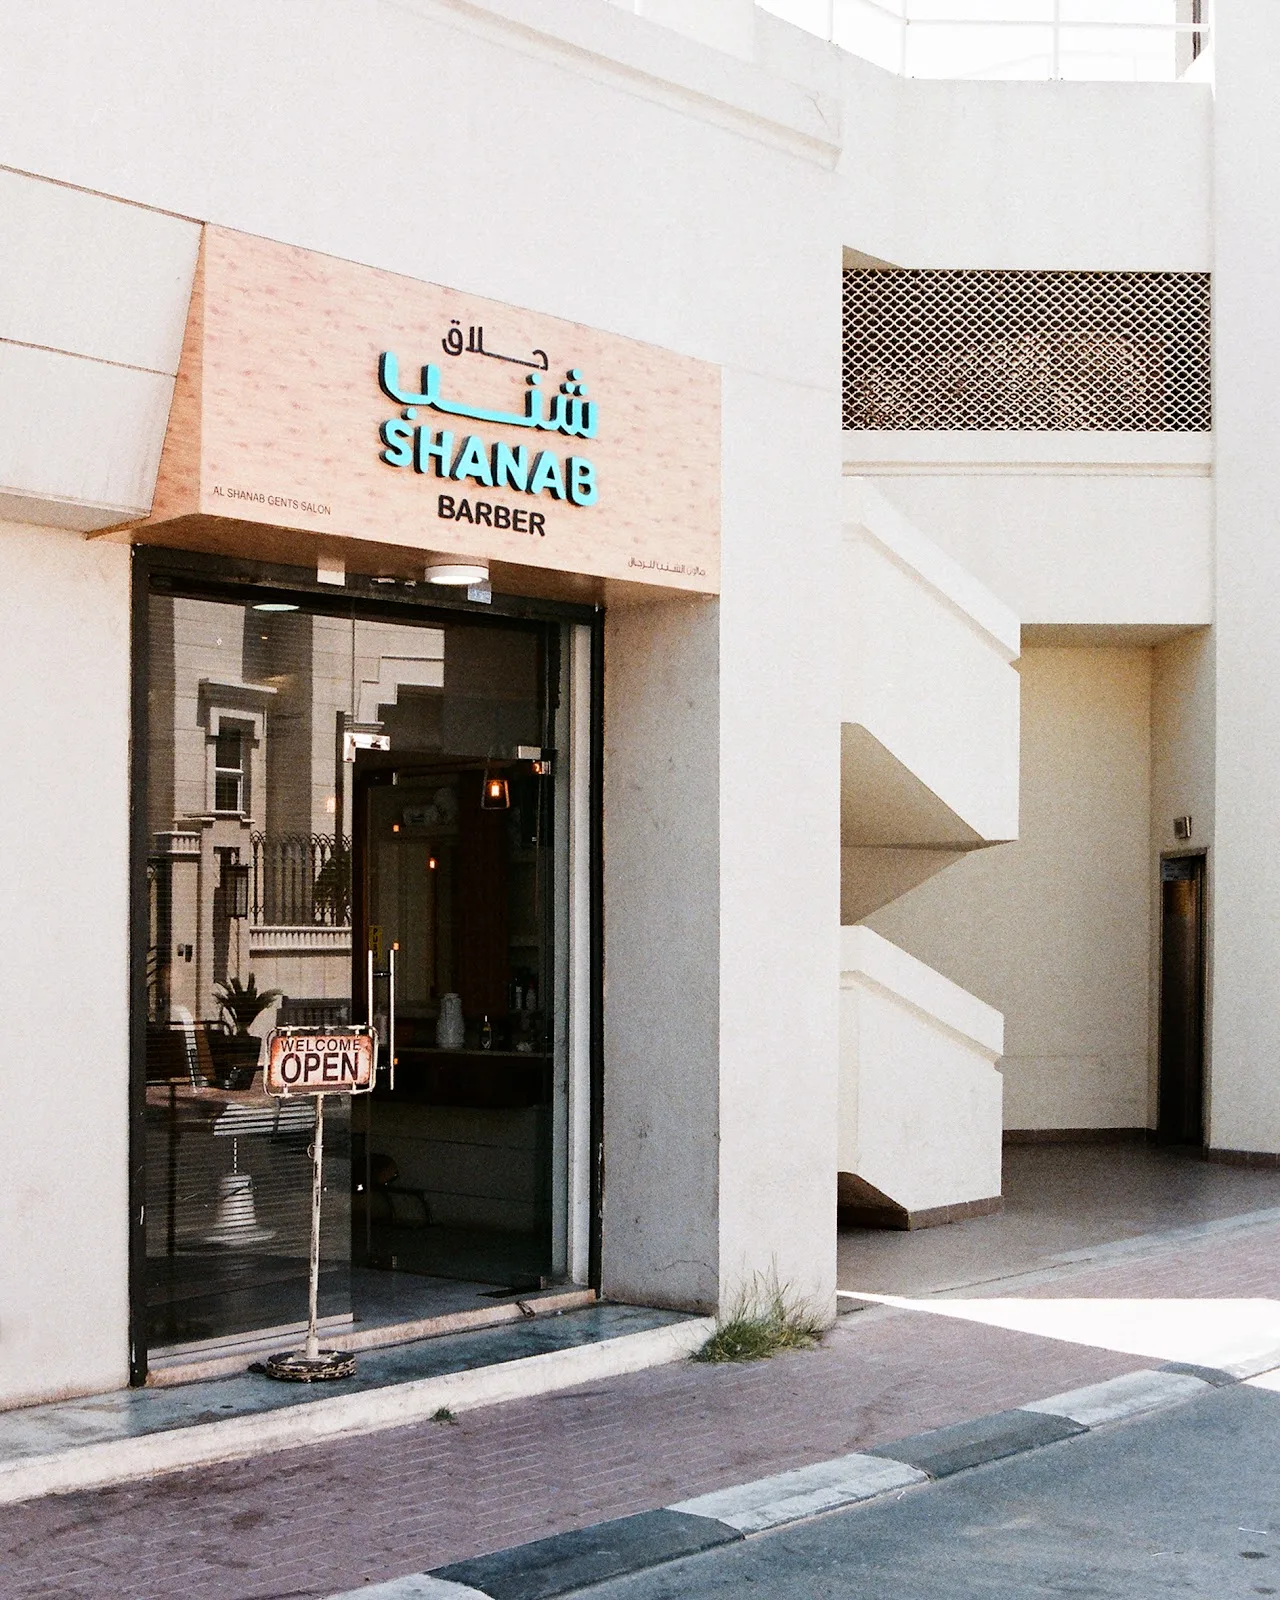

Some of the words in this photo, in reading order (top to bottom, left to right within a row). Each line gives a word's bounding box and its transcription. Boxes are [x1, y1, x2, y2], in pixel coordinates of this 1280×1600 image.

[442, 319, 548, 371] حلاق
[378, 351, 599, 439] شنب
[379, 418, 599, 507] SHANAB
[213, 486, 225, 497] AL
[227, 488, 265, 503] SHANAB
[267, 495, 299, 510] GENTS
[301, 501, 331, 515] SALON
[437, 494, 546, 537] BARBER
[280, 1039, 362, 1053] WELCOME
[280, 1052, 359, 1083] OPEN
